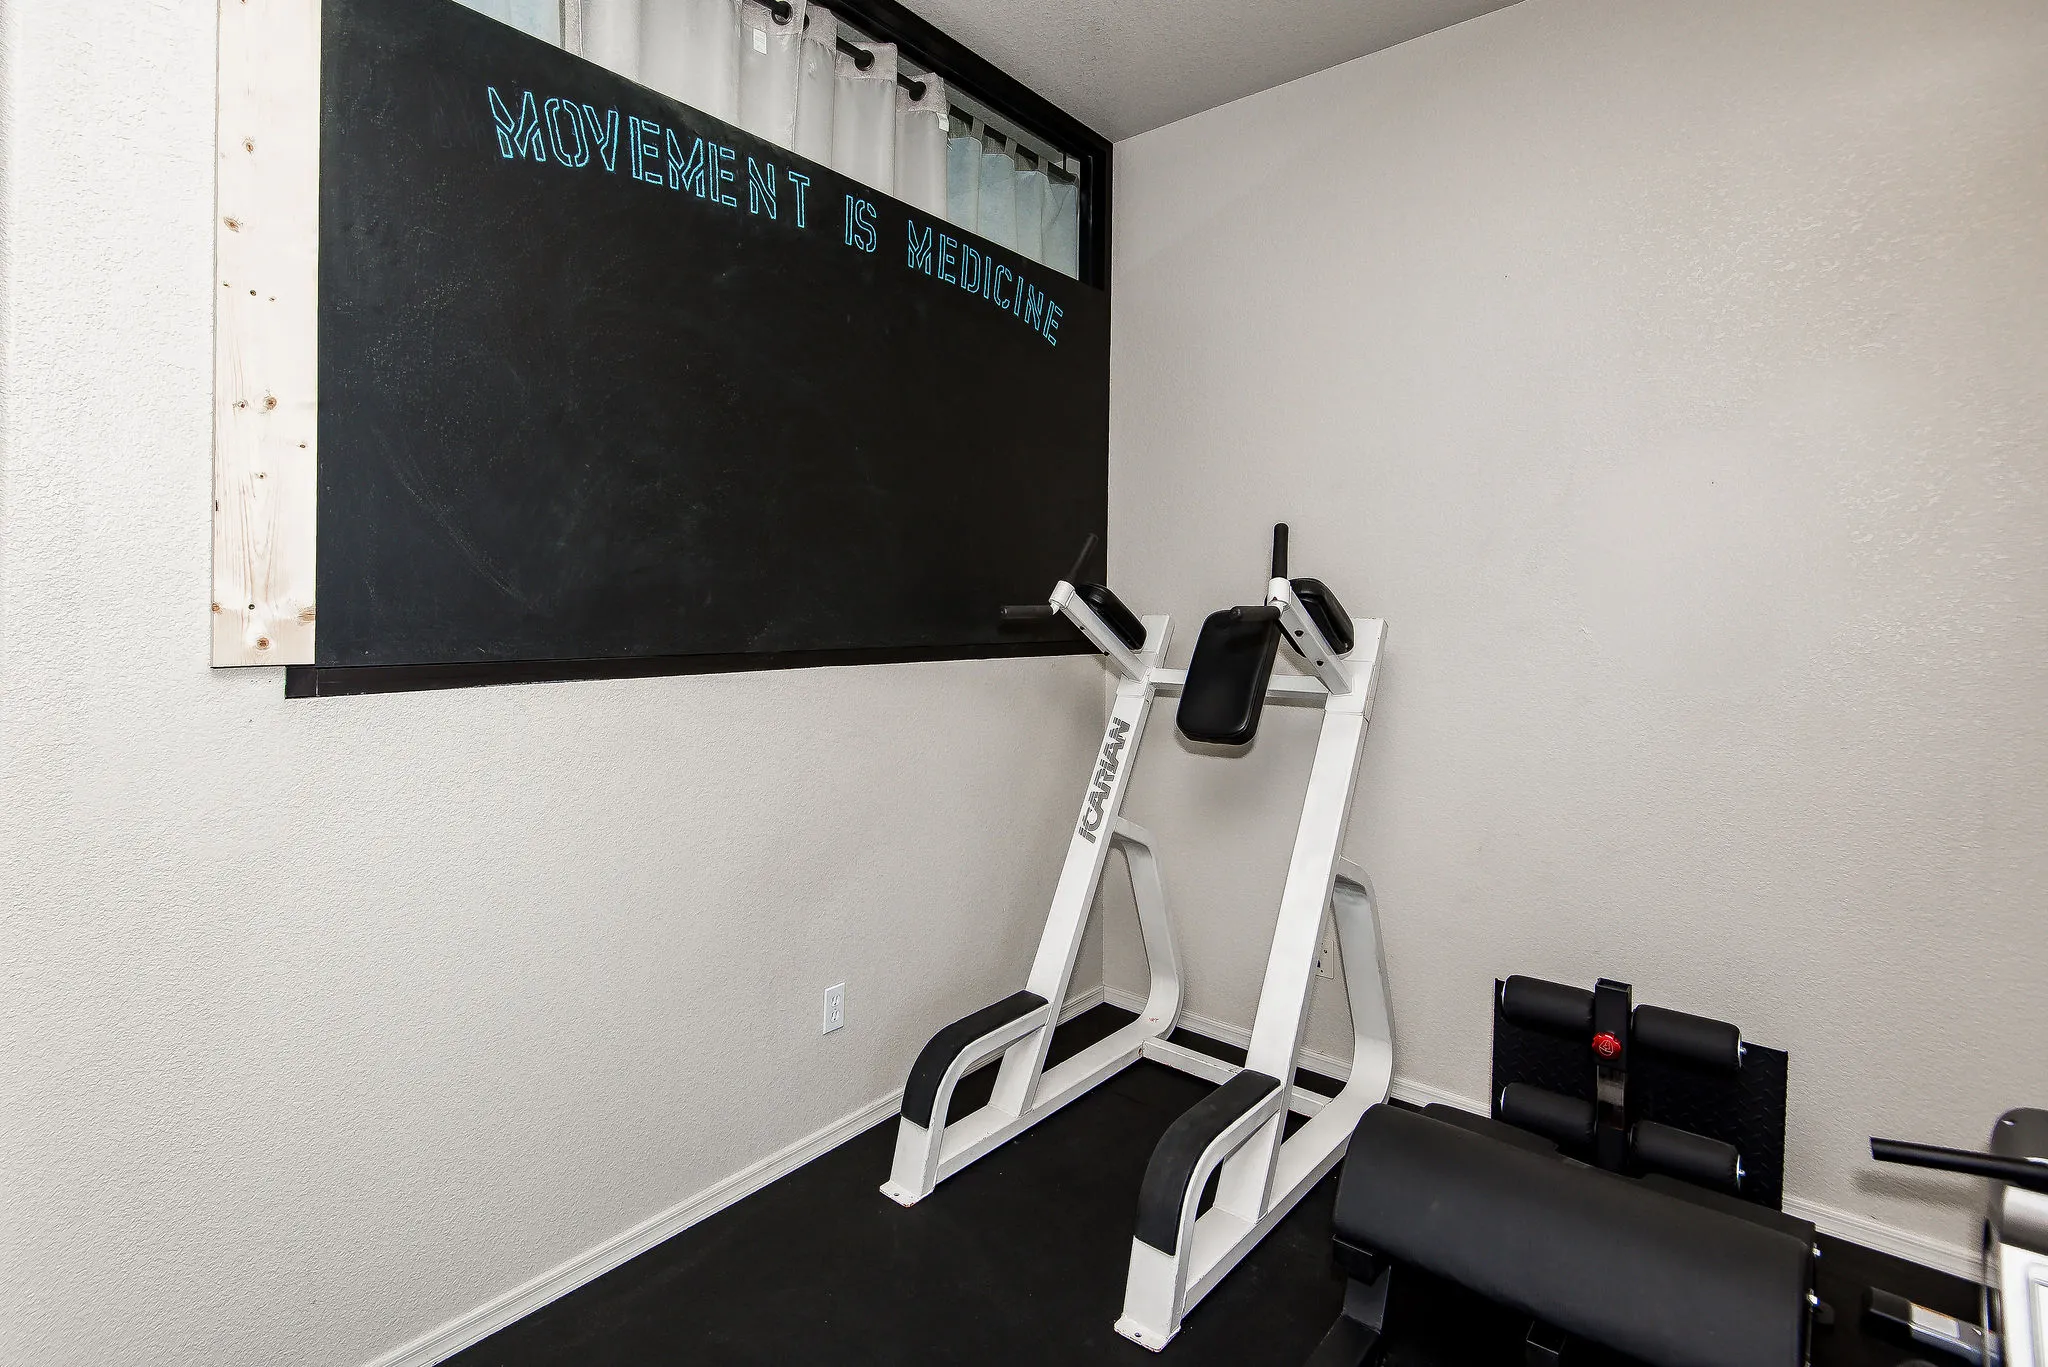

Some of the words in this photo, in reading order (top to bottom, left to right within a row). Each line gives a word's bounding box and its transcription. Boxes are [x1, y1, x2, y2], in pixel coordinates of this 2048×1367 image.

[487, 86, 810, 228] MOVEMENT
[844, 194, 877, 253] IS
[907, 219, 1064, 346] MEDICINE
[1078, 716, 1131, 844] ICARIAN
